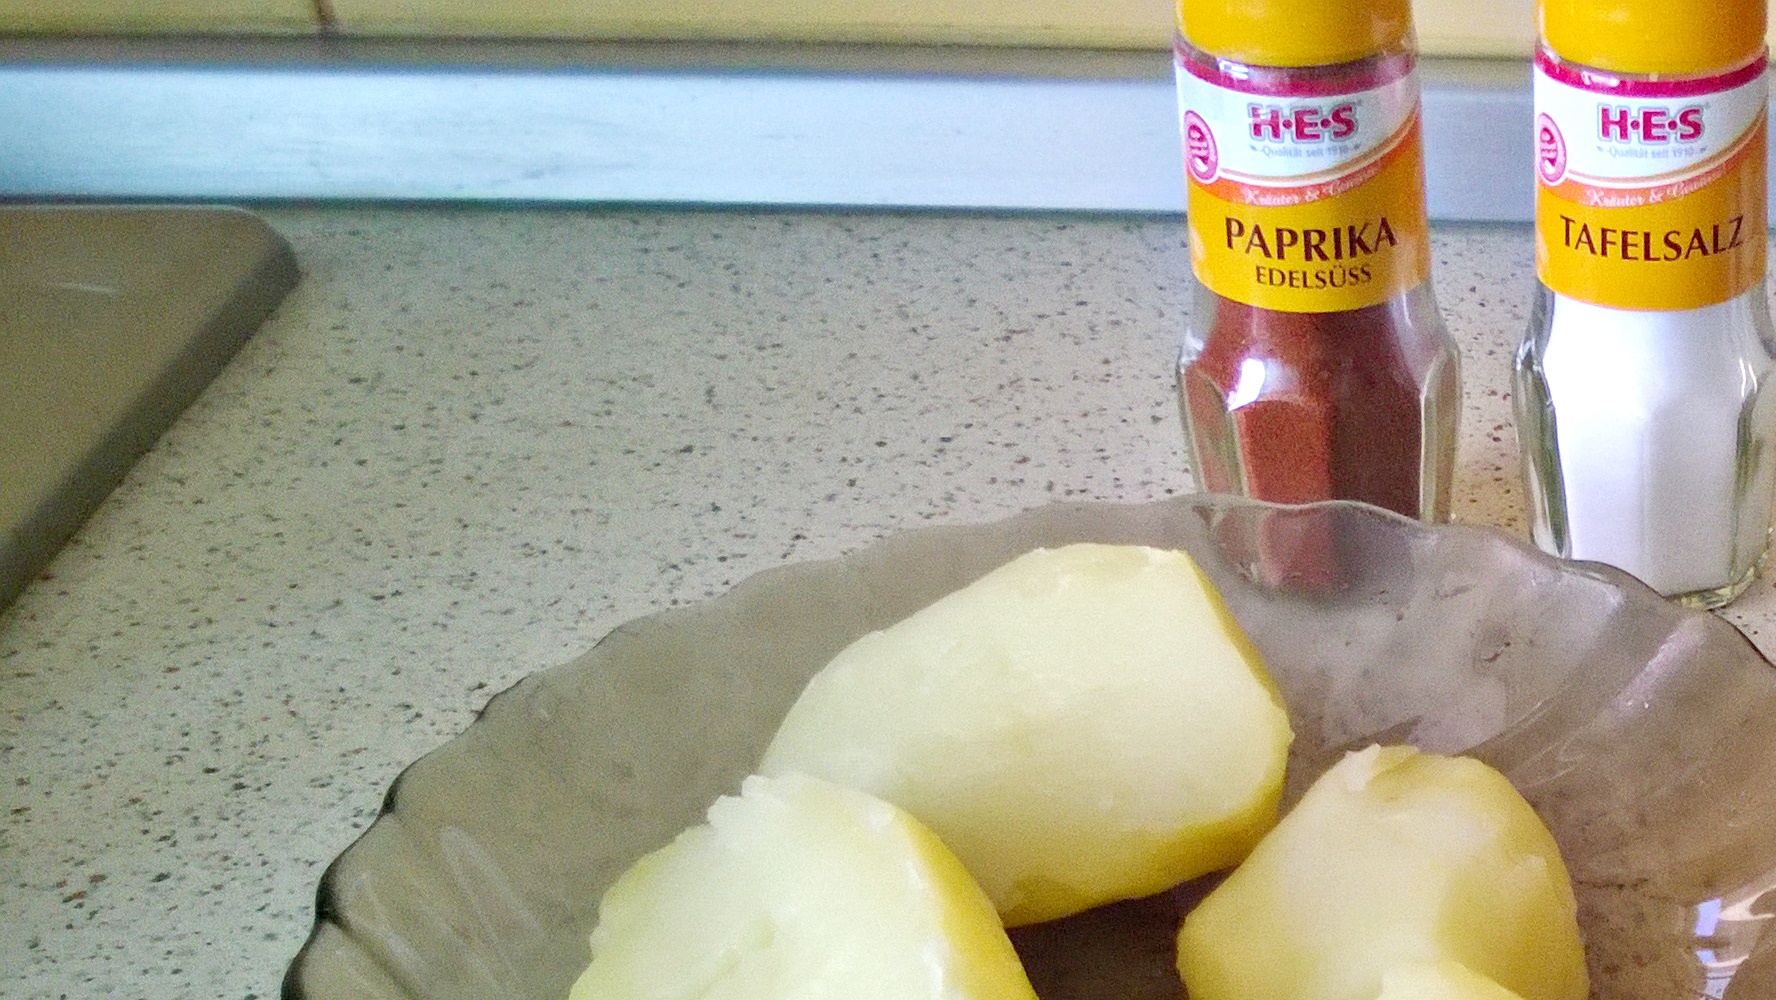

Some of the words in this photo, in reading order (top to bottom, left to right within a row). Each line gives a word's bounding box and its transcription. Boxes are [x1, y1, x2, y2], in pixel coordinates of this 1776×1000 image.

[1224, 216, 1398, 262] PAPRIKA
[1560, 214, 1744, 262] TAFELSALZ
[1256, 264, 1373, 289] EDELSÜSS
